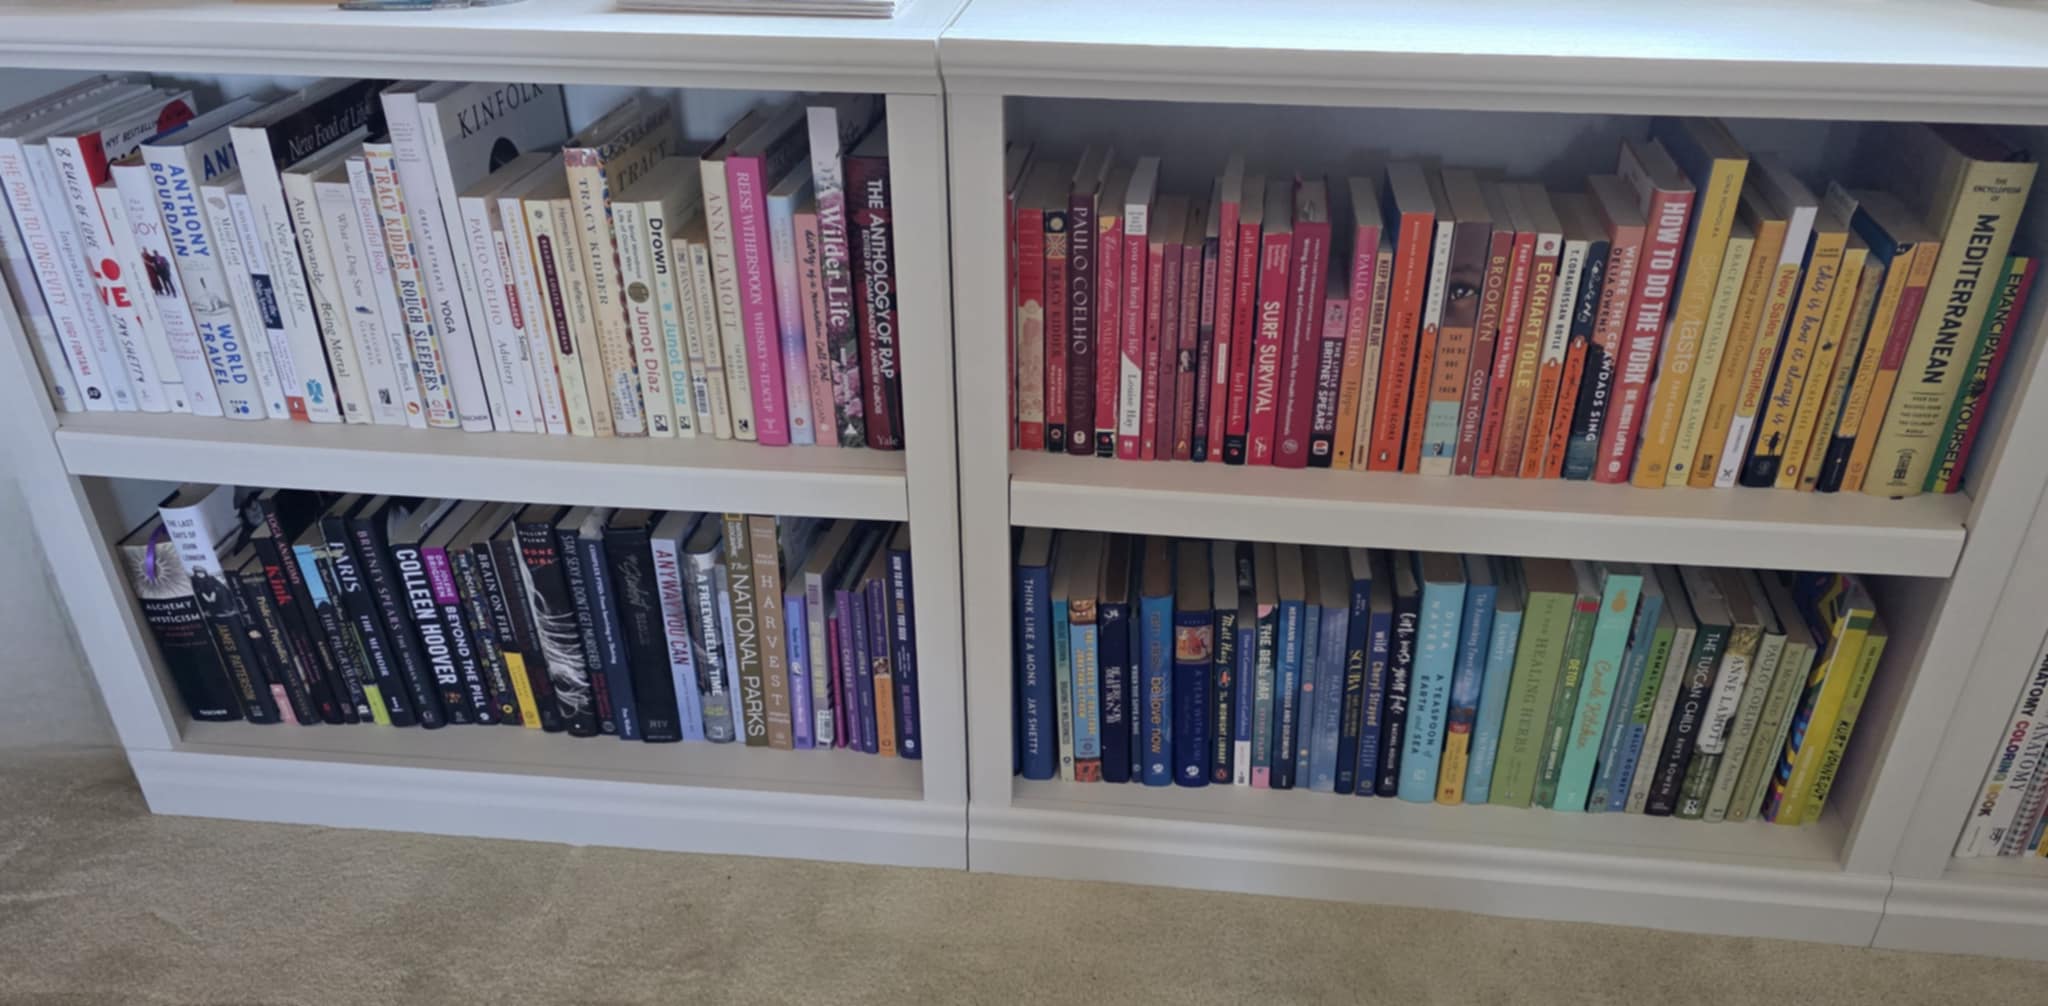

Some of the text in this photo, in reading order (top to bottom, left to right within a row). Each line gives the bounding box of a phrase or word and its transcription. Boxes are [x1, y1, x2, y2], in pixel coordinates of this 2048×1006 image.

[130, 222, 159, 236] JOY
[149, 162, 191, 258] BOURDAIN
[167, 164, 210, 258] ANTHONY
[294, 196, 326, 285] Atul Gawande
[736, 170, 764, 306] REESE WITHERSPOON
[469, 216, 489, 265] PAULO
[479, 264, 503, 327] COELHO
[578, 178, 610, 306] TRACY KIDDER
[648, 217, 669, 275] Drown
[708, 192, 739, 330] ANNE LAMOTT
[819, 203, 848, 283] Wilder
[1128, 241, 1139, 263] you
[373, 166, 441, 393] TRACY KIDDER ROUGH SLEEPERS
[826, 286, 851, 328] Life
[865, 178, 896, 380] THE ANTHOLOGY OF RAP
[1072, 207, 1089, 355] PAULO COELHO
[1130, 286, 1141, 310] heal
[1354, 253, 1372, 302] PAULO
[1479, 255, 1506, 342] BROOKLYN
[1597, 247, 1623, 334] DELIA OWENS
[1623, 202, 1688, 385] HOW TO DO THE WORK
[1775, 269, 1797, 299] New
[1811, 264, 1834, 295] this
[1920, 214, 2000, 384] MEDITERRANEAN
[112, 313, 146, 384] JAY SHETTY
[319, 301, 351, 379] Being Mortal
[439, 300, 457, 335] YOGA
[634, 306, 653, 354] Junot
[1127, 311, 1138, 337] your
[1127, 336, 1139, 356] life
[1348, 307, 1365, 368] COELHO
[1516, 261, 1554, 389] ECKHART TOLLE
[1584, 246, 1638, 443] WHERE THE CRAWDADS SING
[1764, 303, 1787, 340] Sales.
[1796, 314, 1821, 346] how
[1972, 273, 2025, 381] EMANCIPATE
[199, 321, 231, 385] TRAVEL
[217, 322, 249, 385] WORLD
[1254, 301, 1280, 415] SURF SURVIVAL
[1330, 361, 1341, 388] LITTLE
[1335, 342, 1344, 359] THE
[1124, 373, 1138, 429] Louise Hay
[1313, 340, 1335, 432] BRITNEY SPEARS
[1327, 389, 1337, 414] GUIDE
[1471, 369, 1485, 401] COLM
[1680, 376, 1709, 452] ANNE LAMOTT
[1772, 365, 1803, 409] always
[266, 512, 300, 586] YOGA ANATOMY
[328, 541, 362, 594] PARIS
[355, 528, 401, 632] BRITNEY SPEARS
[425, 553, 446, 599] BRIGHTEN
[146, 601, 192, 612] ALCHEMY
[265, 565, 294, 606] Kink
[476, 552, 497, 594] BRAIN
[496, 613, 513, 643] FIRE
[655, 549, 691, 668] ANYWAY YOU CAN
[1023, 579, 1036, 613] THINK
[149, 614, 201, 624] MYSTICISM
[359, 613, 391, 679] THE MEMOIR
[395, 548, 459, 687] COLLEEN HOOVER
[730, 573, 761, 671] NATIONAL
[760, 576, 784, 706] HARVEST
[1024, 616, 1037, 641] LIKE
[1217, 614, 1235, 666] Matt Haig
[1703, 633, 1721, 654] THE
[444, 605, 489, 711] BEYOND THE PILL
[1025, 653, 1037, 687] MONK
[1256, 623, 1274, 702] THE BELL JAR
[1346, 650, 1363, 692] SCUBA
[1366, 630, 1389, 727] wild Cheryl Strayed
[1524, 637, 1549, 703] HEALING
[1564, 657, 1582, 688] DETOX
[1691, 656, 1714, 701] TUSCAN
[1722, 656, 1745, 697] ANNE
[743, 675, 767, 738] PARKS
[1026, 697, 1038, 717] JAY
[1426, 685, 1444, 747] TEASPOON
[1678, 700, 1699, 735] CHILD
[1741, 643, 1779, 738] PAULO COELHO
[1026, 718, 1039, 755] SHETTY
[1672, 737, 1687, 760] RHYS
[1704, 698, 1734, 751] LAMOTT
[1993, 720, 2030, 782] COLORING
[1617, 726, 1643, 795] SALLY ROONEY
[1660, 761, 1679, 796] BOWEN
[1814, 719, 1851, 803] KURT VONNEGUT
